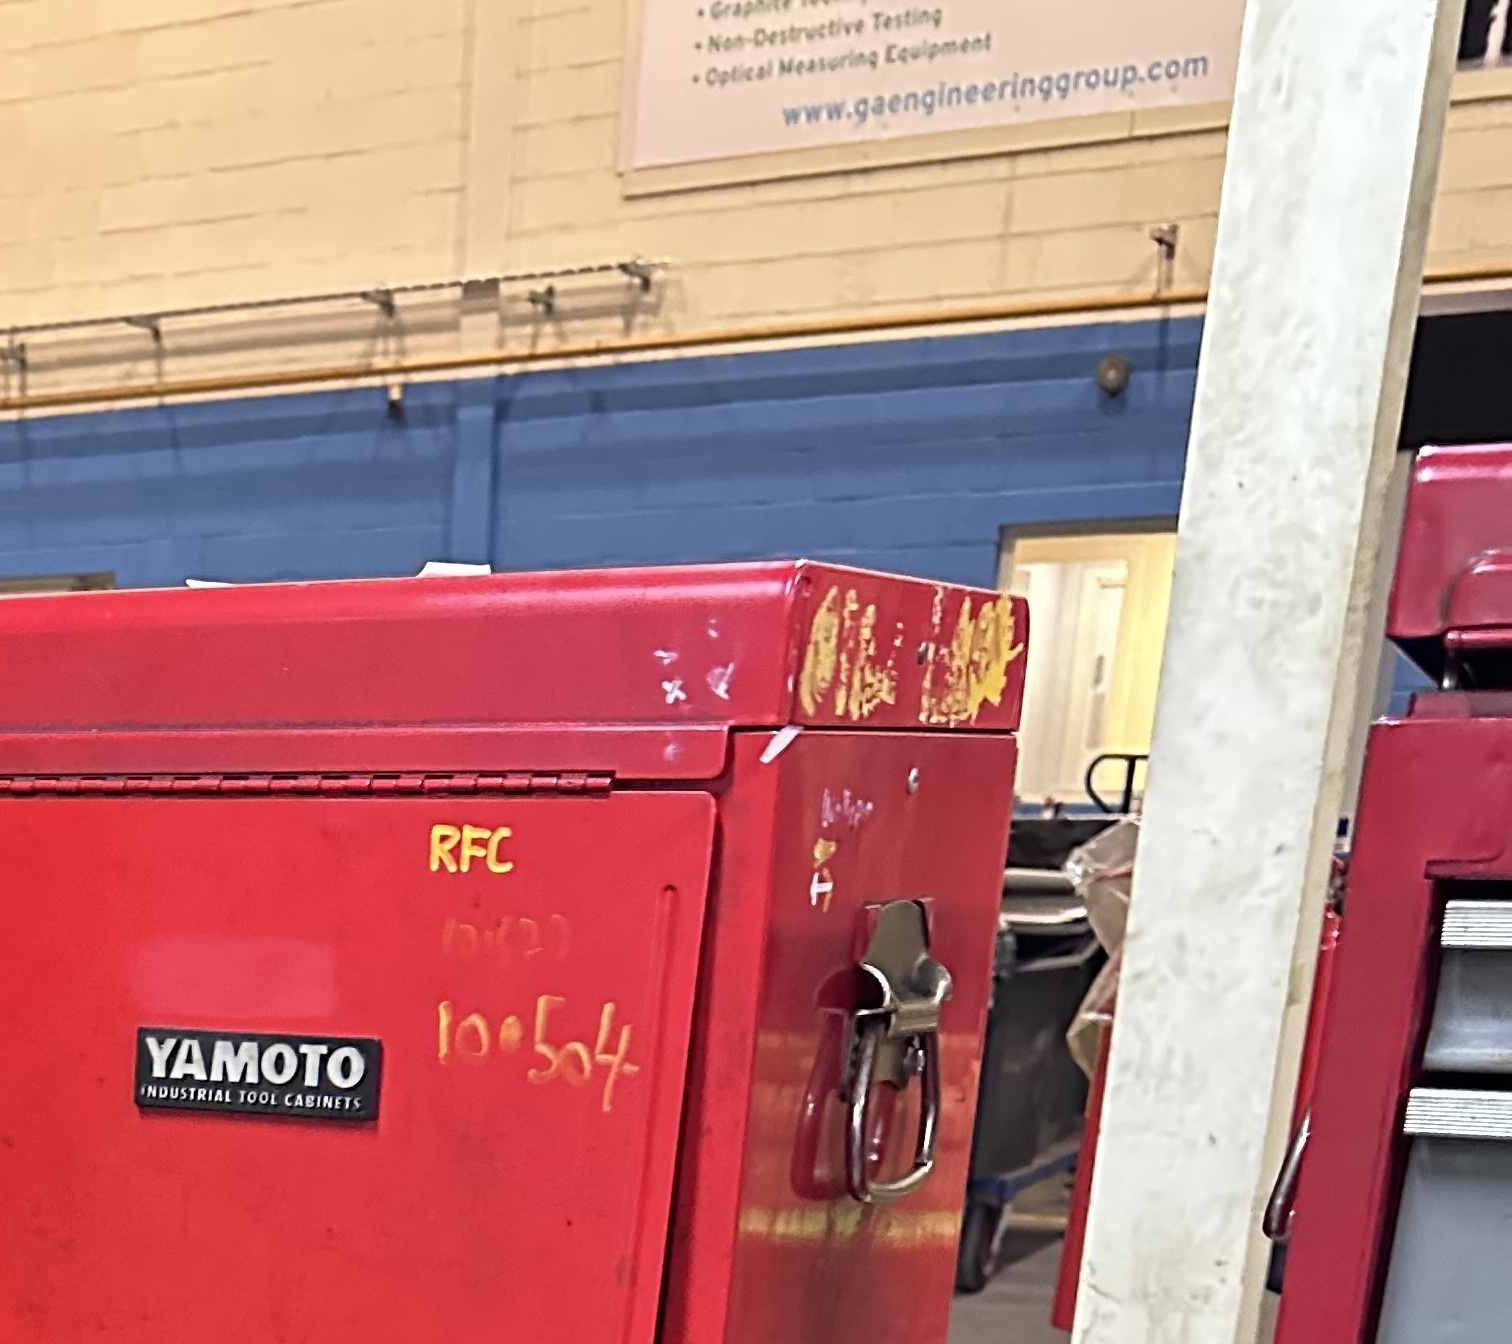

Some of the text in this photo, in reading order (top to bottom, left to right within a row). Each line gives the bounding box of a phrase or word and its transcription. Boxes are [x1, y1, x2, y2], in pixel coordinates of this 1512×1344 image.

[707, 8, 943, 52] Non-Destructive Testing
[705, 32, 992, 87] Optical Measuring Equipment
[782, 54, 1209, 127] www.gaengineeringgroup.com
[429, 823, 514, 874] RFC
[144, 1036, 366, 1089] YAMOTO
[140, 1084, 363, 1111] INDUSTRIAL TOOL CABINETS
